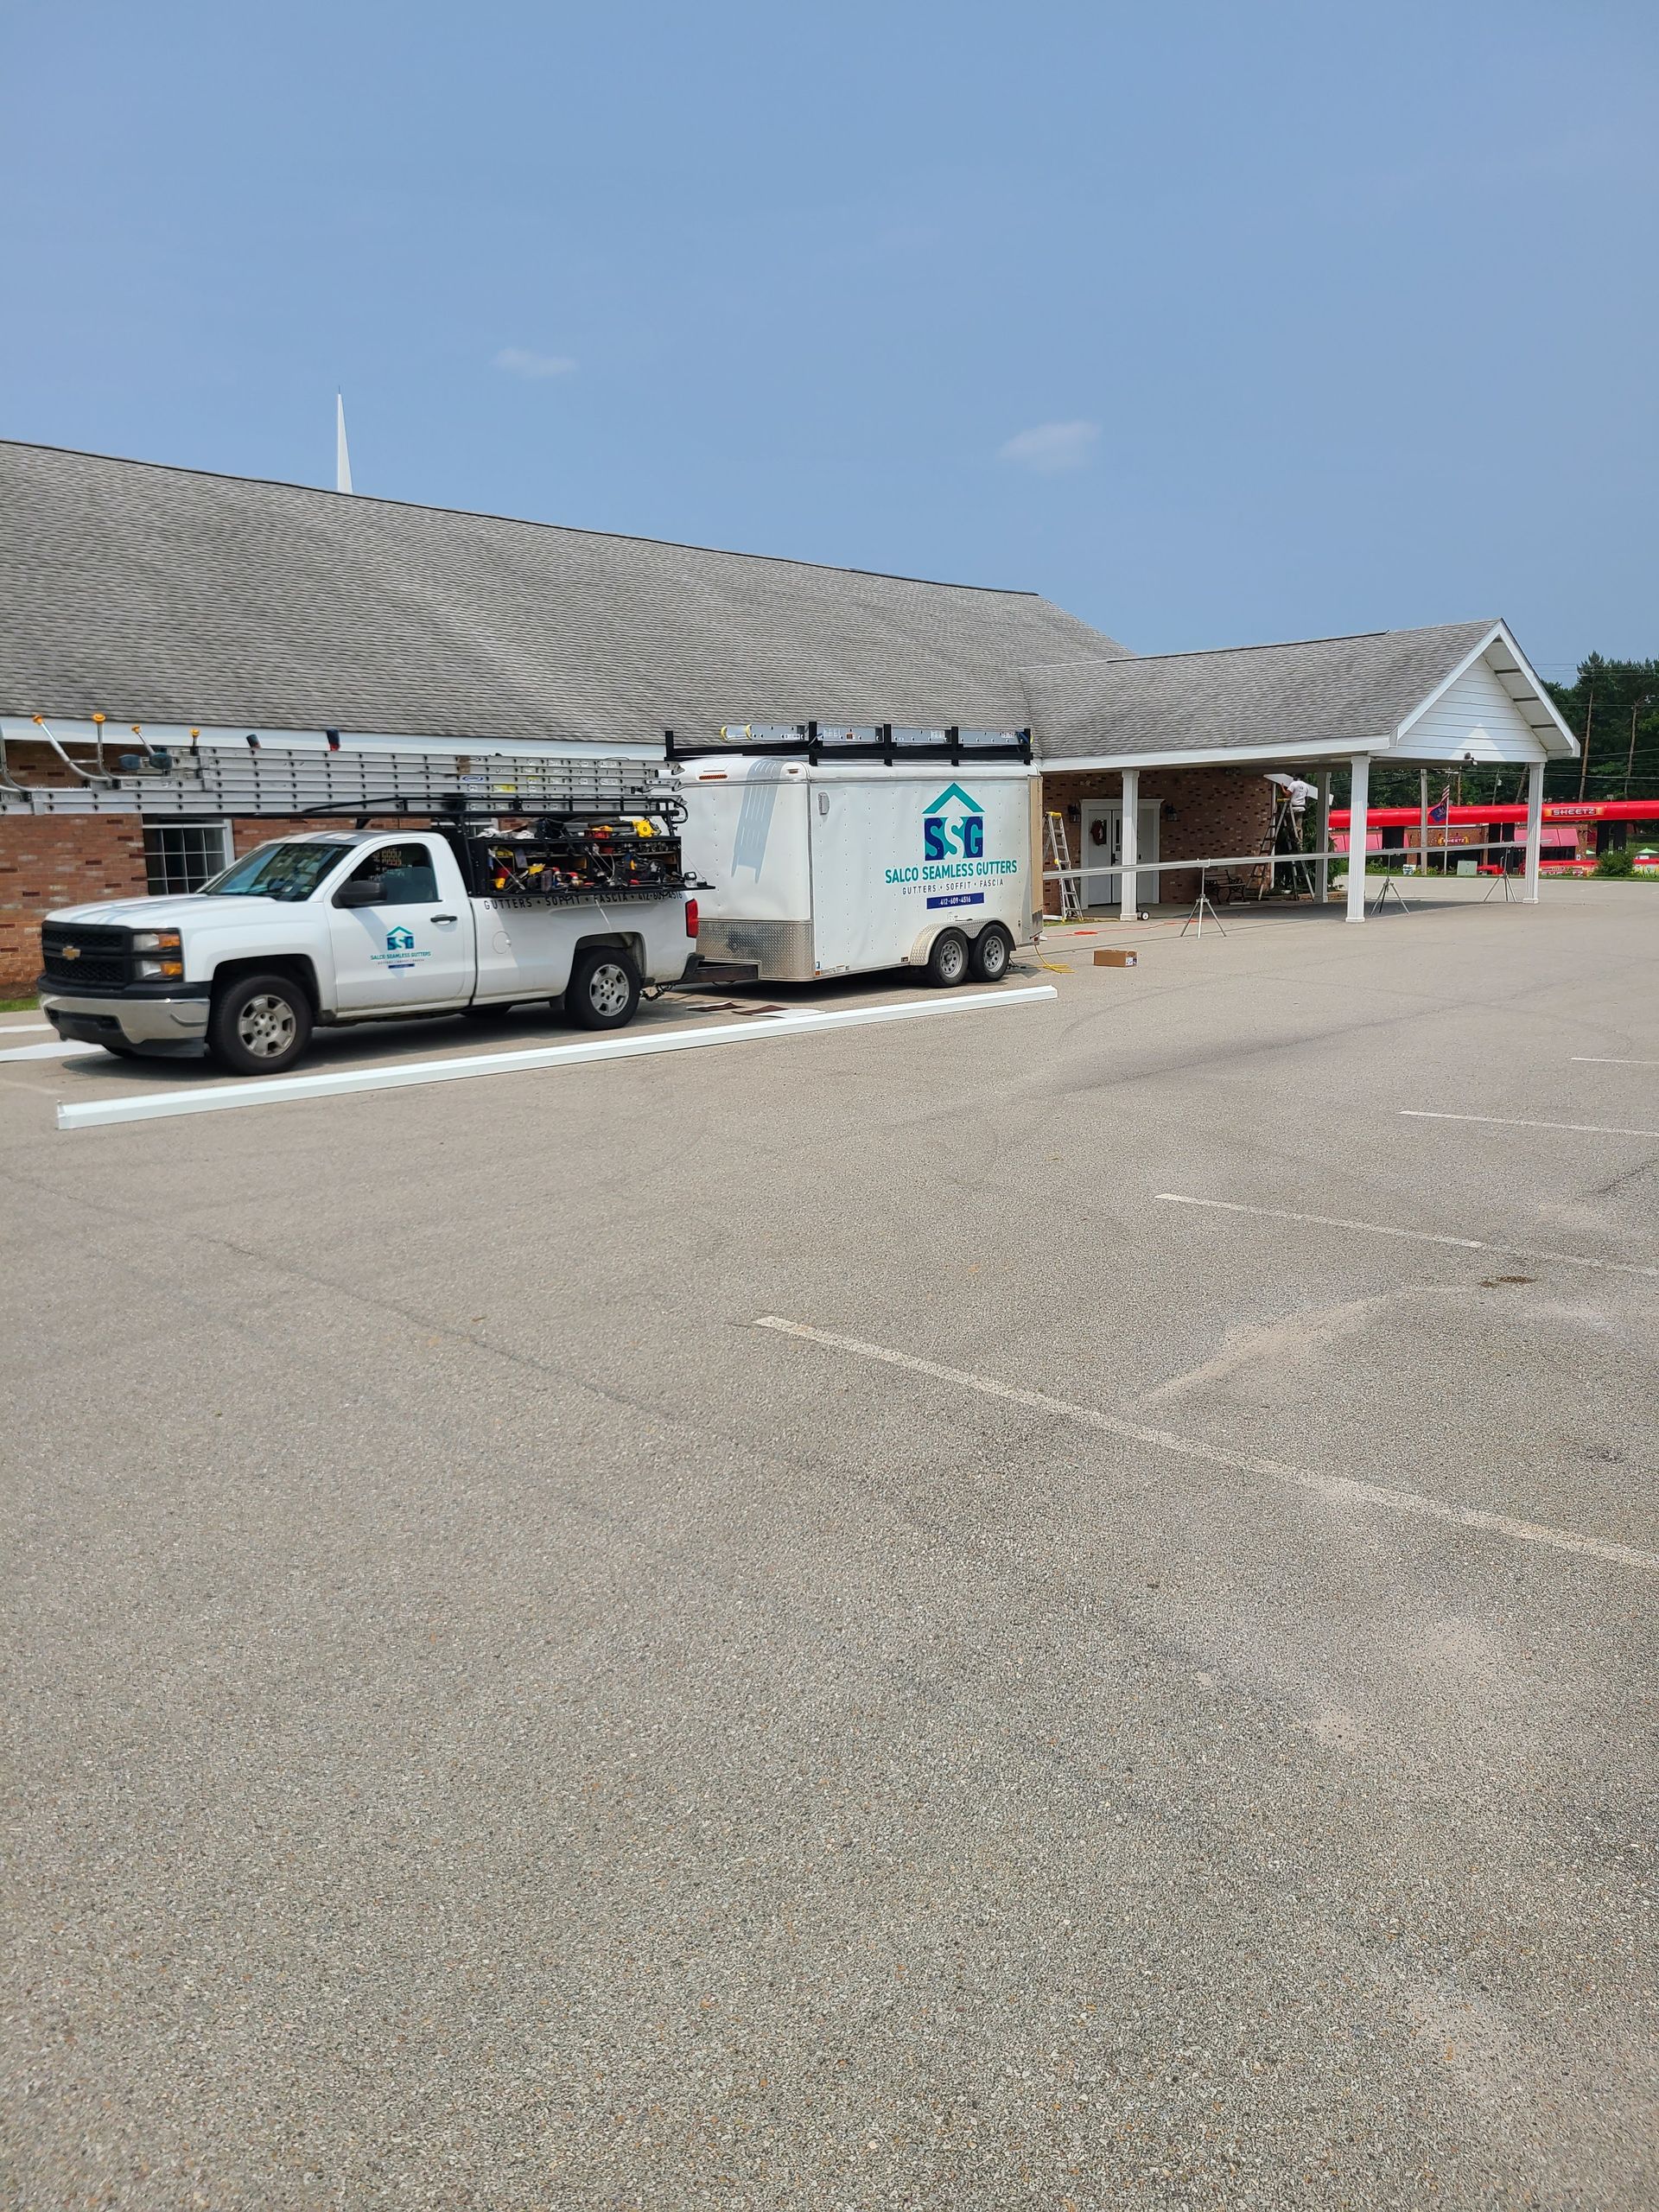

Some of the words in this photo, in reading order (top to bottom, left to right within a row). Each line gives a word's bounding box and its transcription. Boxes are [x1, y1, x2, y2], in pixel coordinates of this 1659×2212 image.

[925, 817, 983, 861] SSG
[885, 867, 918, 883] SALCO
[922, 863, 974, 880] SEAMLESS
[976, 860, 1018, 876] GUTTERS
[902, 884, 937, 895] GUTTERS
[946, 881, 971, 891] SOFFIT
[979, 879, 1004, 888] FASCIA
[484, 899, 532, 910] GUTTERS
[593, 893, 628, 904] FASCIA
